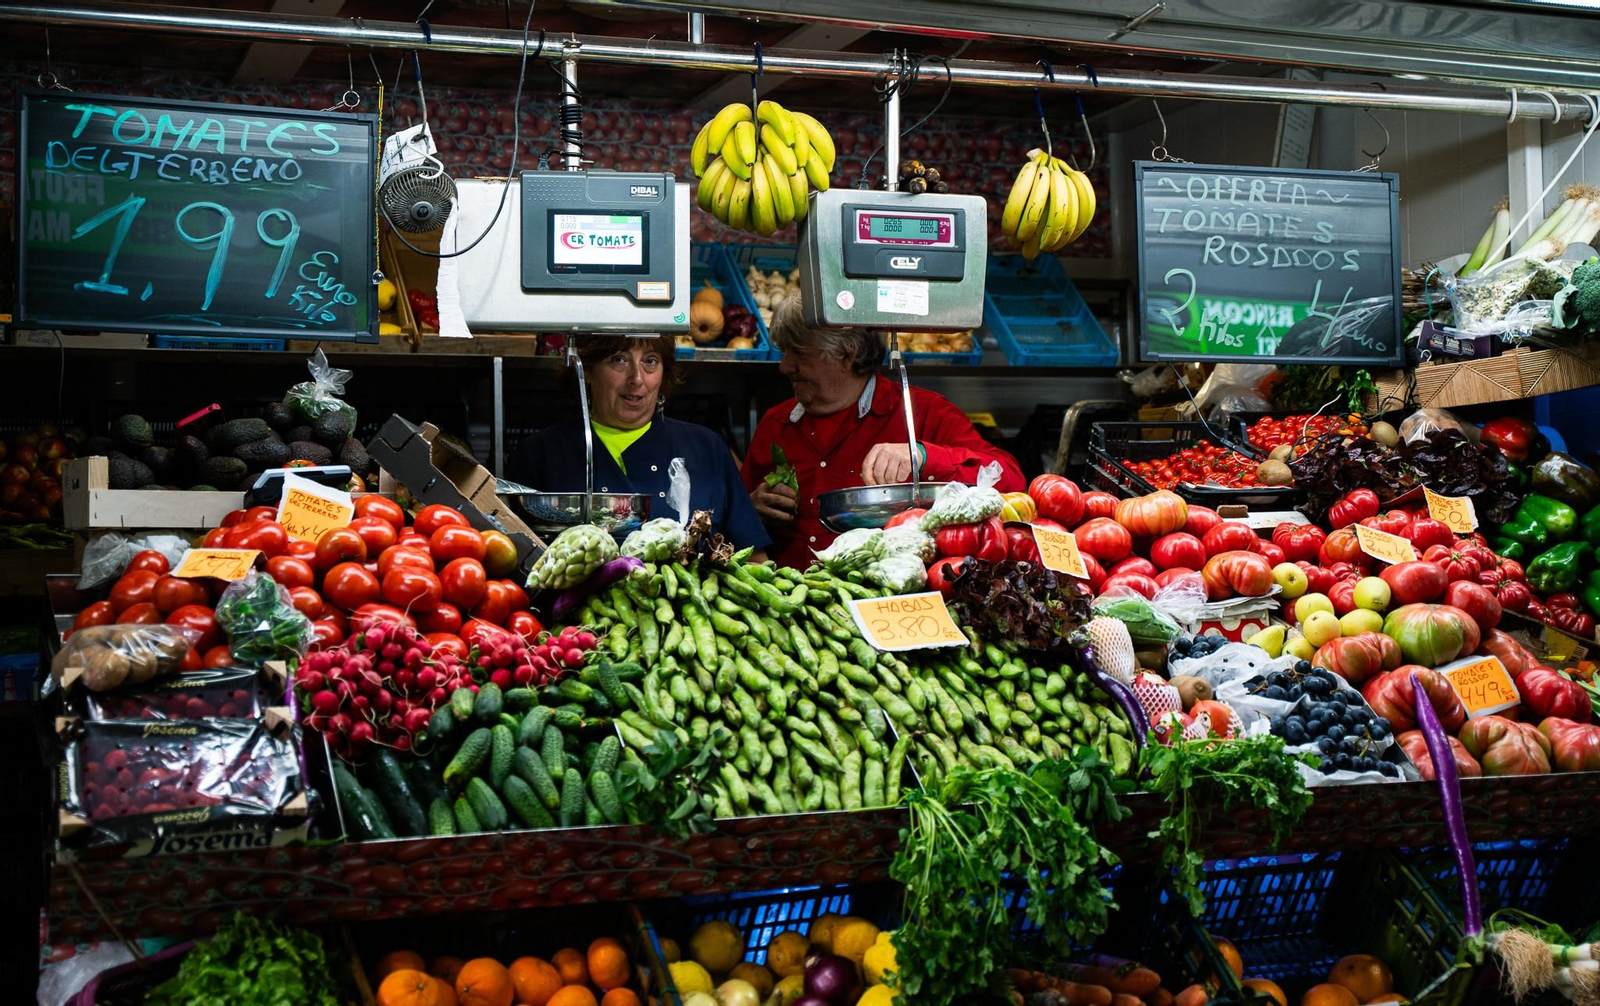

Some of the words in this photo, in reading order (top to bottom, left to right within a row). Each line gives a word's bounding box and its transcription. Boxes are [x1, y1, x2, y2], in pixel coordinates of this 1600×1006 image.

[65, 103, 340, 156] TOMATES
[630, 186, 659, 195] DIBAL
[1153, 208, 1335, 244] TOMATES
[72, 192, 301, 311] 1.99
[588, 234, 635, 247] TOMATE
[890, 256, 922, 270] CELY
[1160, 267, 1198, 337] 2
[1308, 279, 1353, 349] 4
[292, 491, 343, 514] TOMATES
[280, 512, 292, 526] 2
[312, 525, 329, 543] 4
[1448, 662, 1494, 681] TOMATES
[142, 721, 198, 739] Josema
[144, 829, 273, 857] Josema
